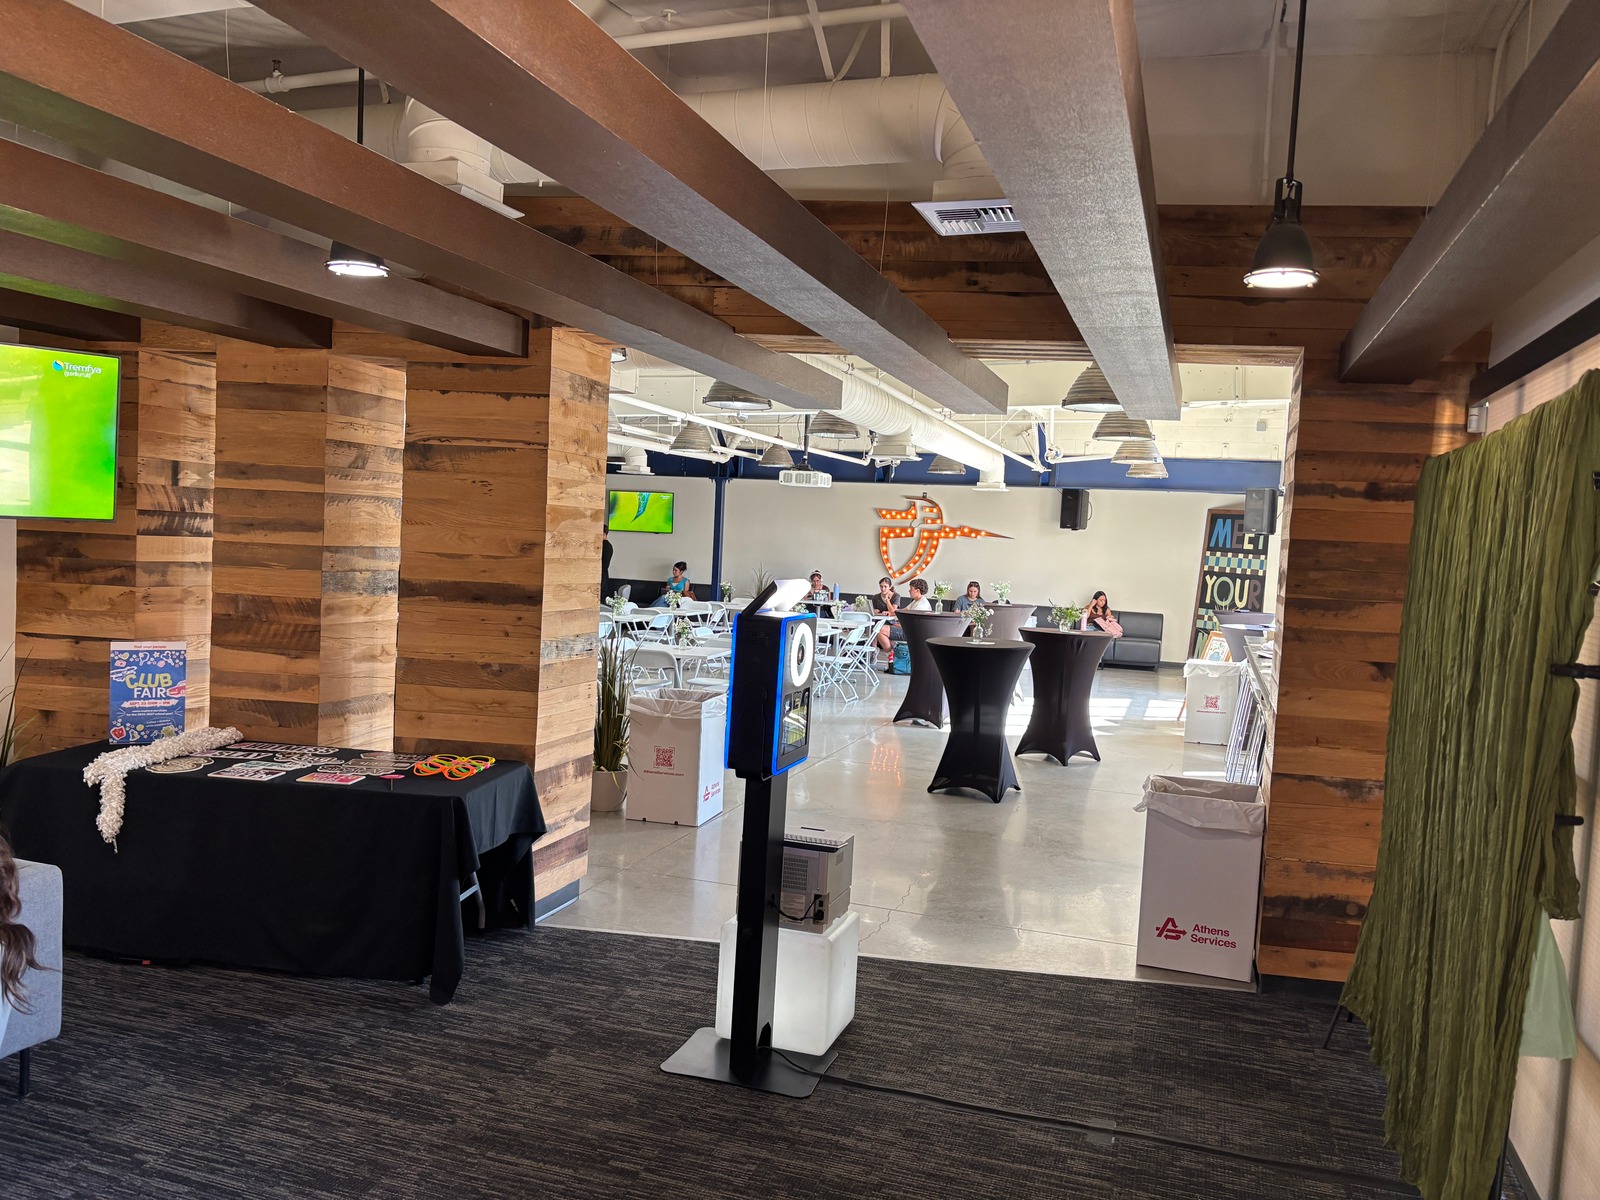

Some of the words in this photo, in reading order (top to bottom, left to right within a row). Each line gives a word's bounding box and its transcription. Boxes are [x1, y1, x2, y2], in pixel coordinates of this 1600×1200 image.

[64, 361, 102, 374] Tremfya
[1205, 574, 1261, 609] YOUR
[125, 672, 173, 689] CLUB
[133, 687, 166, 698] FAIR
[1192, 923, 1230, 937] Athens
[1190, 933, 1237, 949] Services
